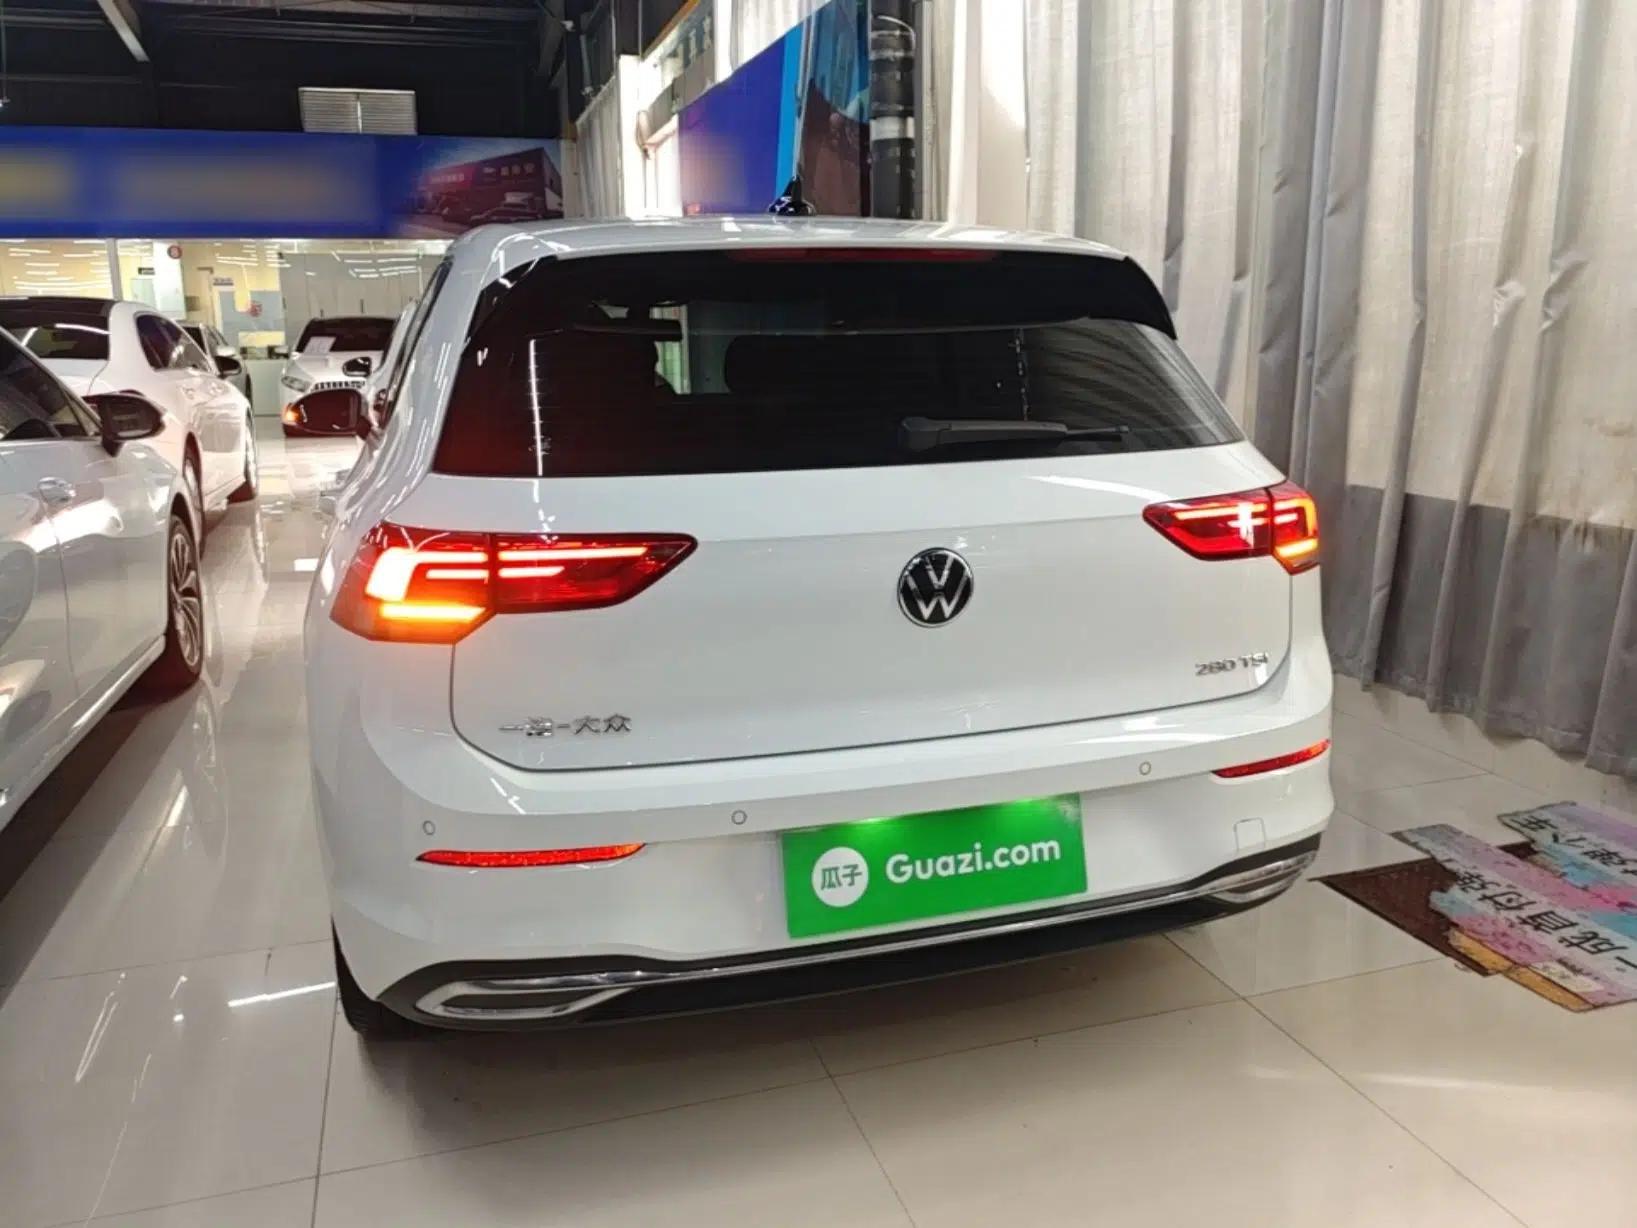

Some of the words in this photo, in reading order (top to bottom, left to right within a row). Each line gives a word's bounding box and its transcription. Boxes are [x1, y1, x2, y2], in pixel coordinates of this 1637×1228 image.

[820, 864, 863, 890] 瓜子
[886, 840, 1061, 884] Guazi.com
[1440, 857, 1637, 969] 一成首付弹
